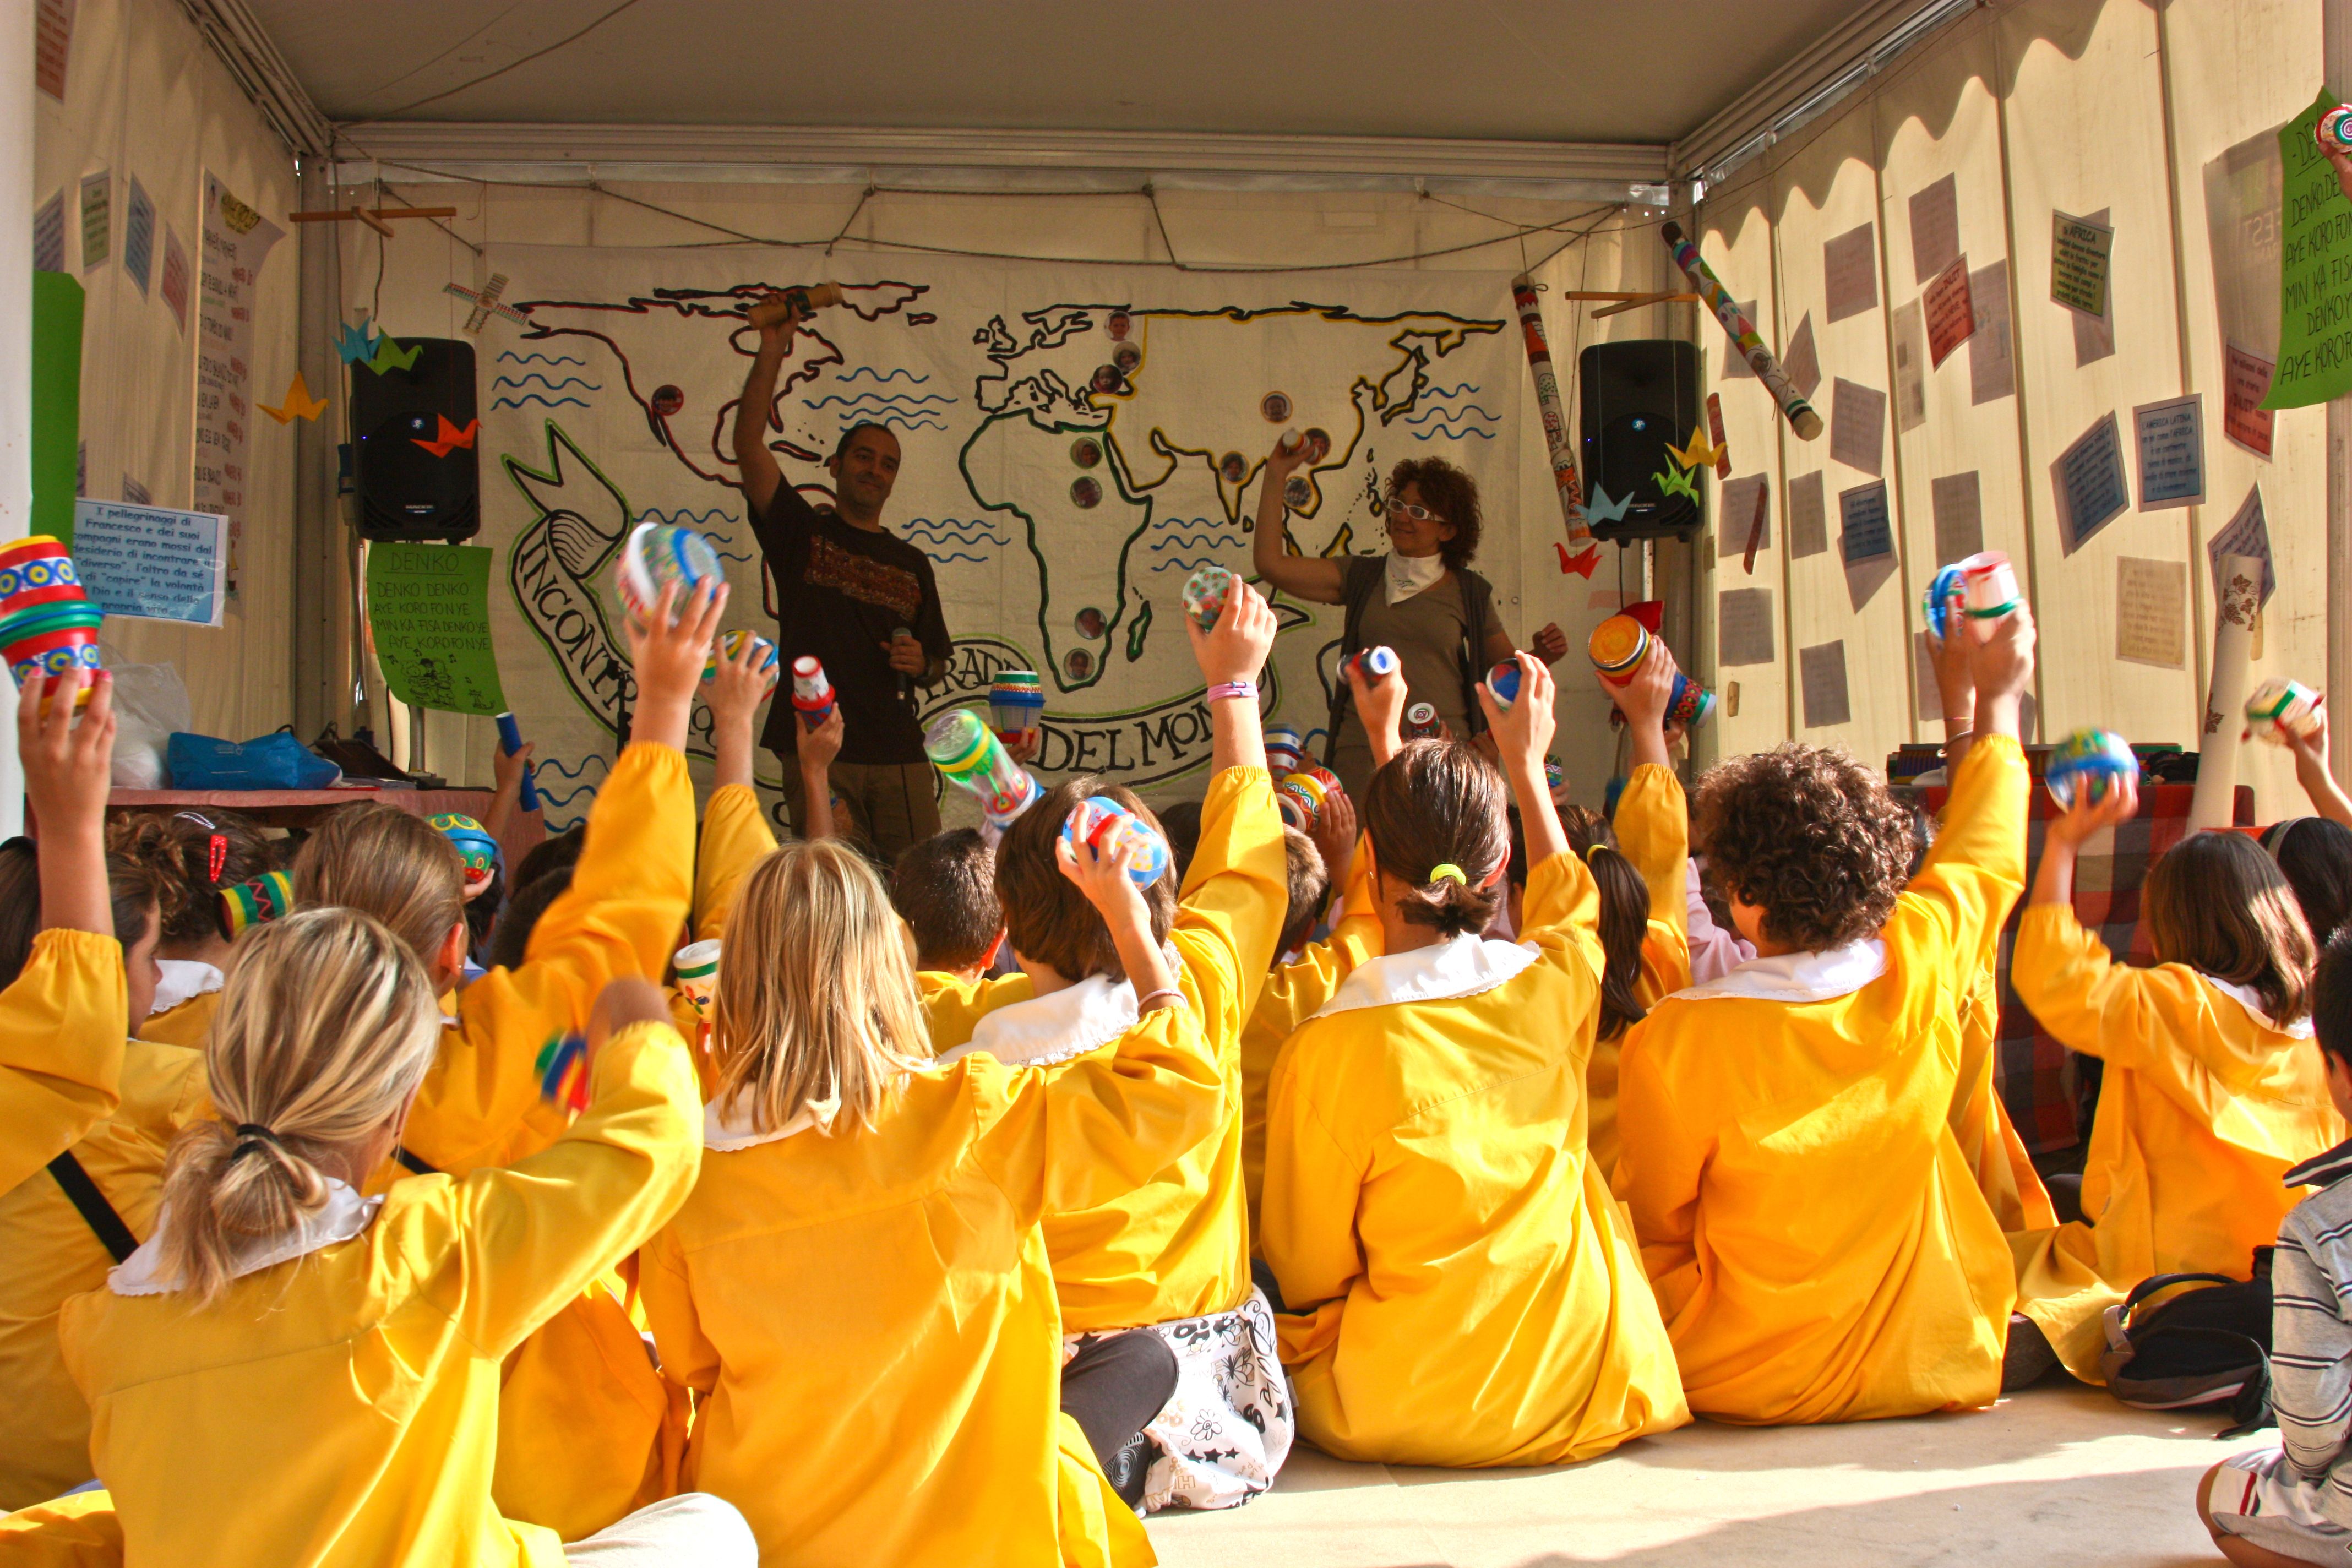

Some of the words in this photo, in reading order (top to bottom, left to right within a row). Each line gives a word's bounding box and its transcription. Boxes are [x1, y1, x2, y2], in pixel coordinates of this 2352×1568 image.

[2069, 225, 2096, 244] AFRICA
[2313, 264, 2327, 300] KA
[2280, 350, 2311, 385] AYE
[97, 507, 104, 515] I
[107, 509, 176, 526] pellegrinaggi
[181, 516, 191, 526] di
[85, 518, 141, 532] Francesco
[157, 527, 174, 537] dei
[179, 531, 200, 540] suoi
[126, 538, 157, 547] erano
[161, 542, 191, 551] mossi
[195, 545, 212, 554] dal
[127, 549, 137, 558] di
[143, 551, 199, 565] incontrare
[391, 552, 459, 572] DENKO
[86, 572, 96, 580] di
[151, 578, 160, 587] la
[137, 563, 168, 575] l'altro
[174, 568, 187, 577] da
[92, 586, 110, 595] Dio
[127, 588, 133, 598] il
[173, 594, 199, 605] della
[377, 582, 420, 597] DENKO
[427, 582, 469, 597] DENKO
[374, 602, 394, 614] AYE
[389, 635, 412, 649] AYE
[1026, 723, 1135, 774] DEL
